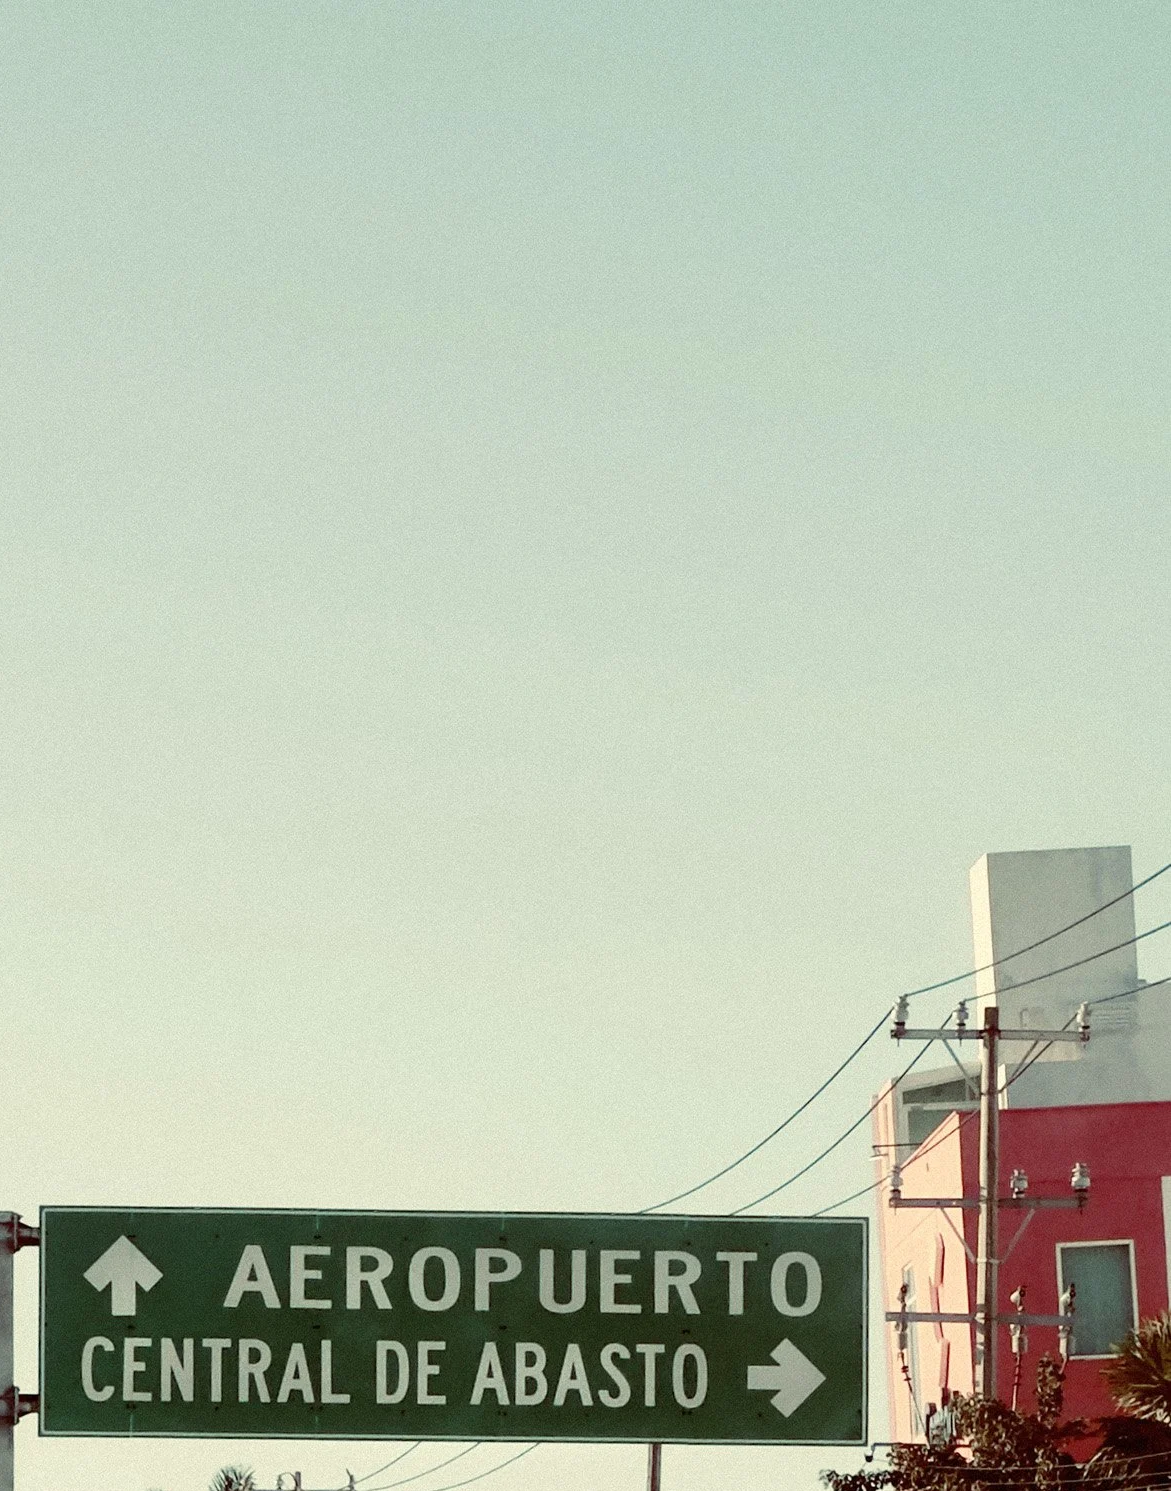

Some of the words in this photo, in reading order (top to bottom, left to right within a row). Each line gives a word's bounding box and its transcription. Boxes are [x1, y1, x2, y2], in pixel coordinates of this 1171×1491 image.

[223, 1244, 822, 1317] AEROPUERTO
[81, 1336, 351, 1403] CENTRAL
[376, 1340, 447, 1405] DE
[469, 1341, 708, 1409] ABASTO
